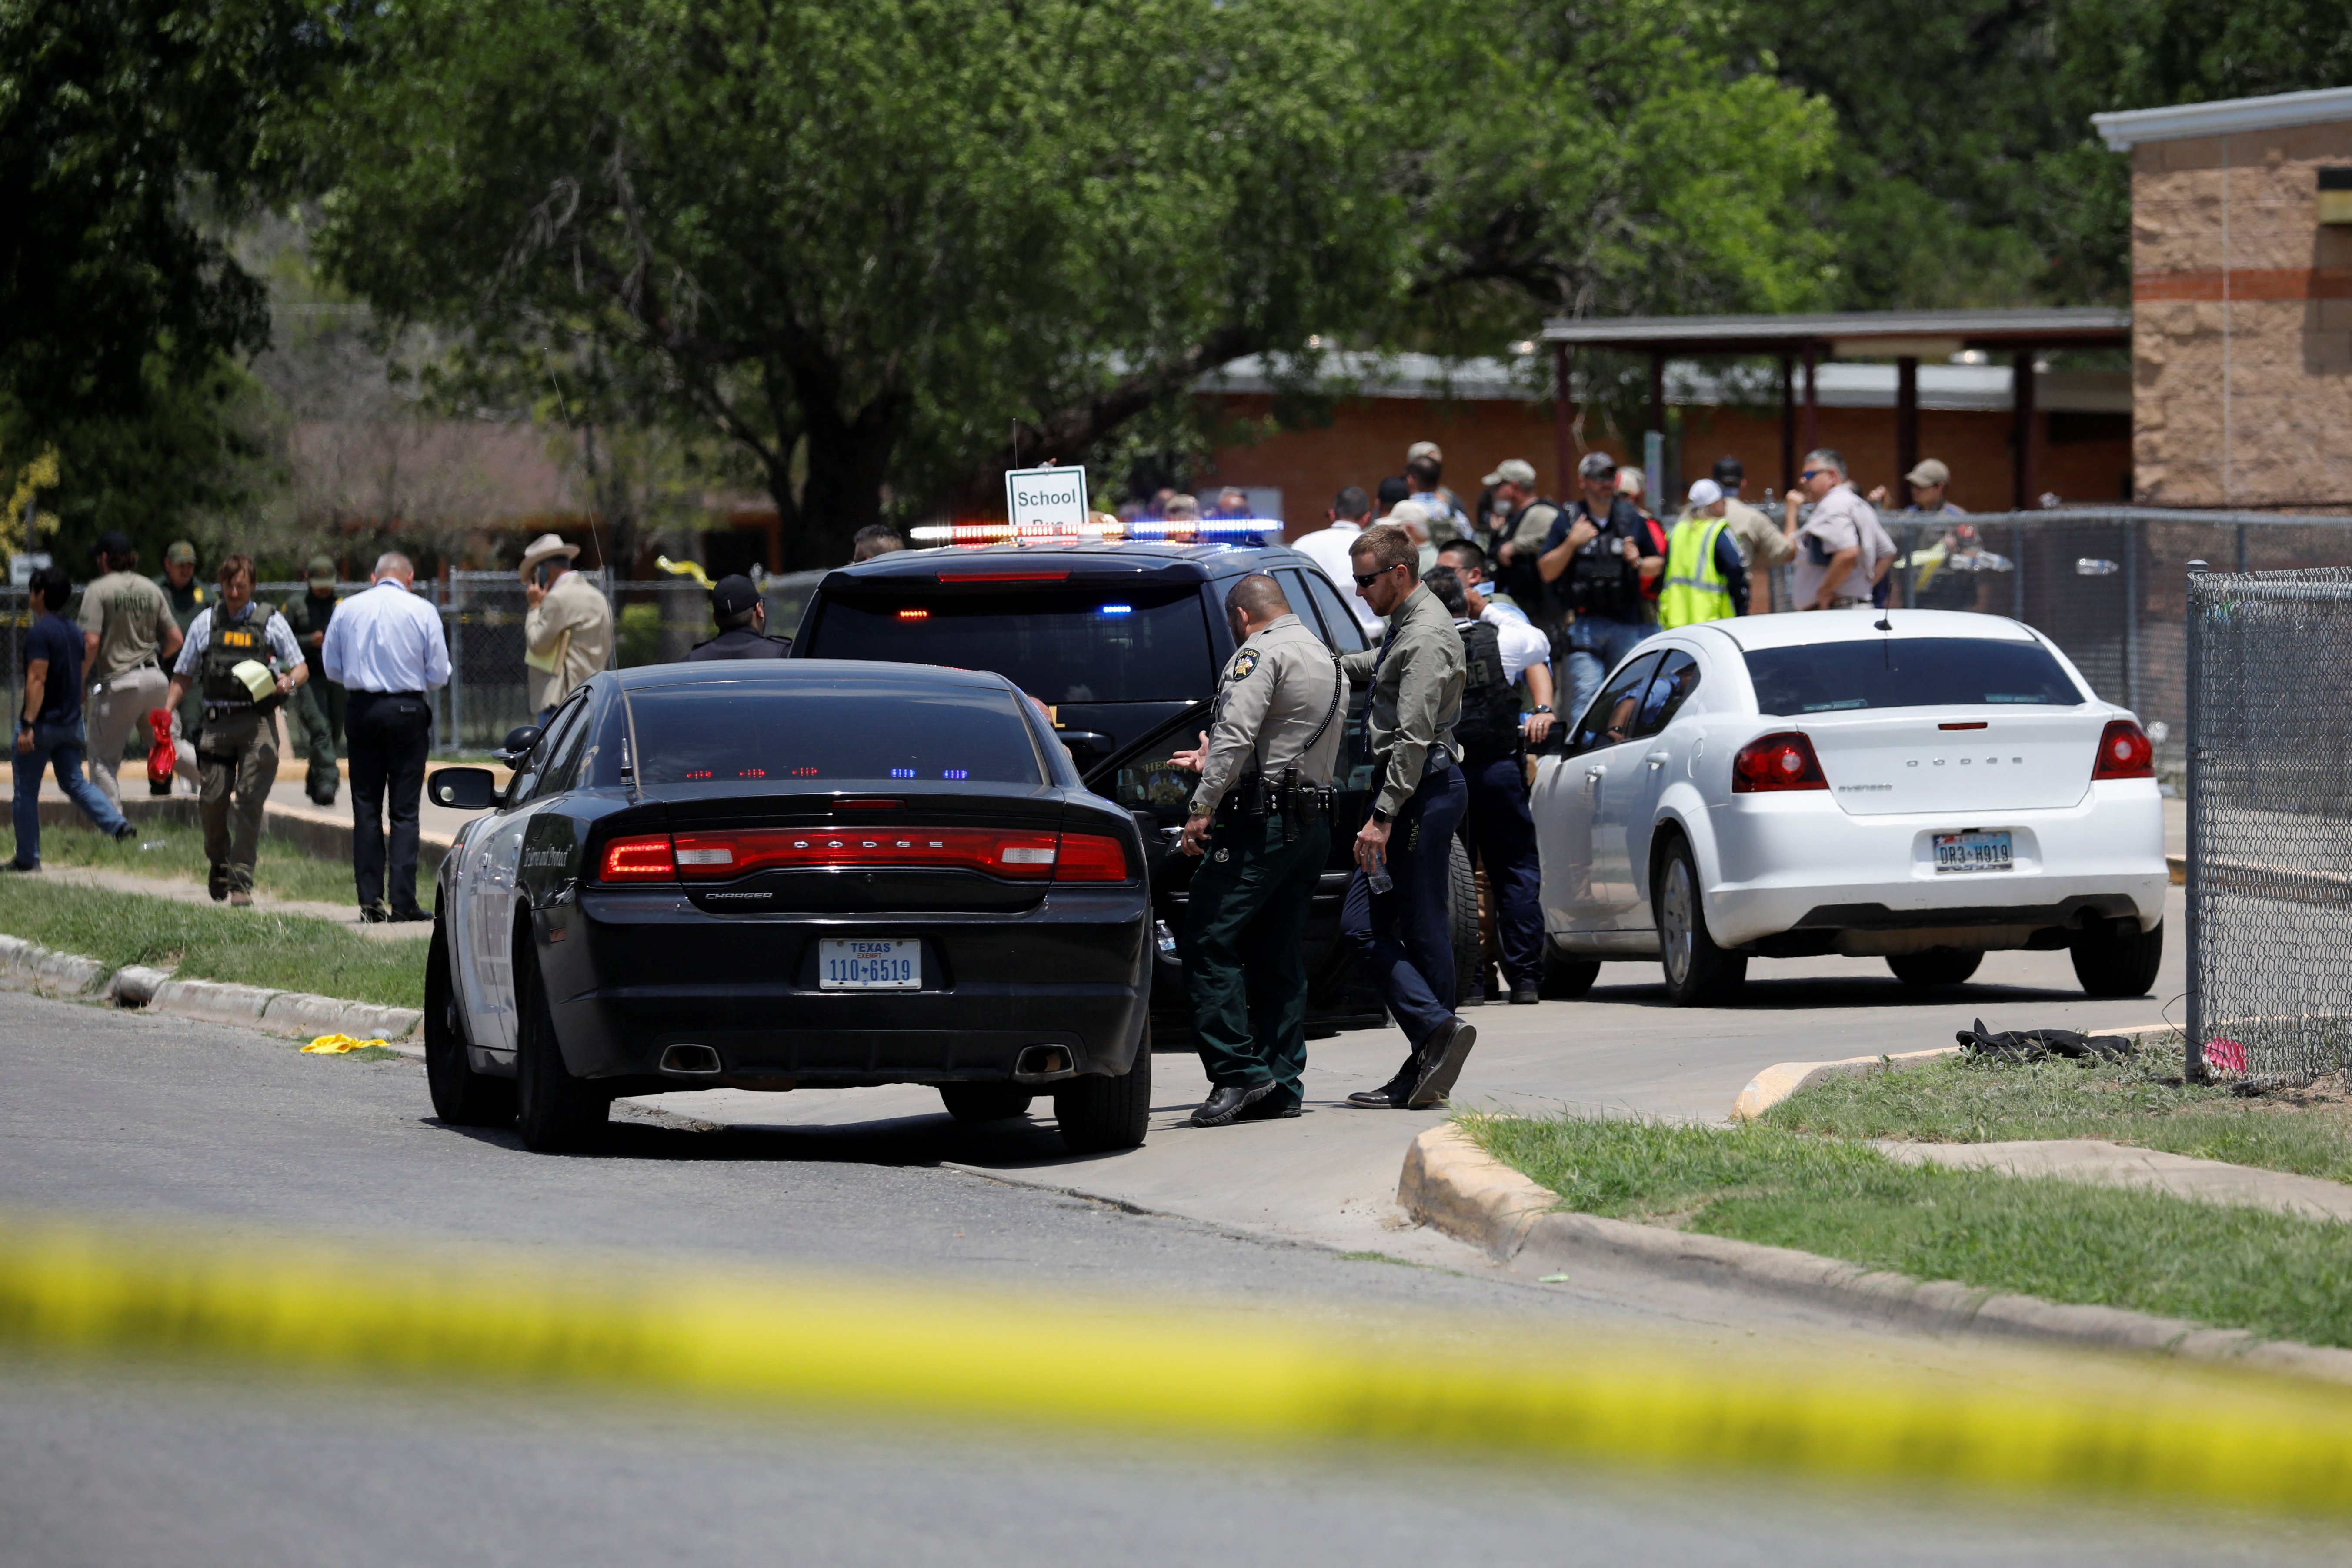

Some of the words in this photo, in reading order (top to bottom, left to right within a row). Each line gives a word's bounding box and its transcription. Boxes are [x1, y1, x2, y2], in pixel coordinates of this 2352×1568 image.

[1018, 489, 1075, 506] School
[224, 631, 251, 647] FBI
[851, 943, 890, 952] TEXAS
